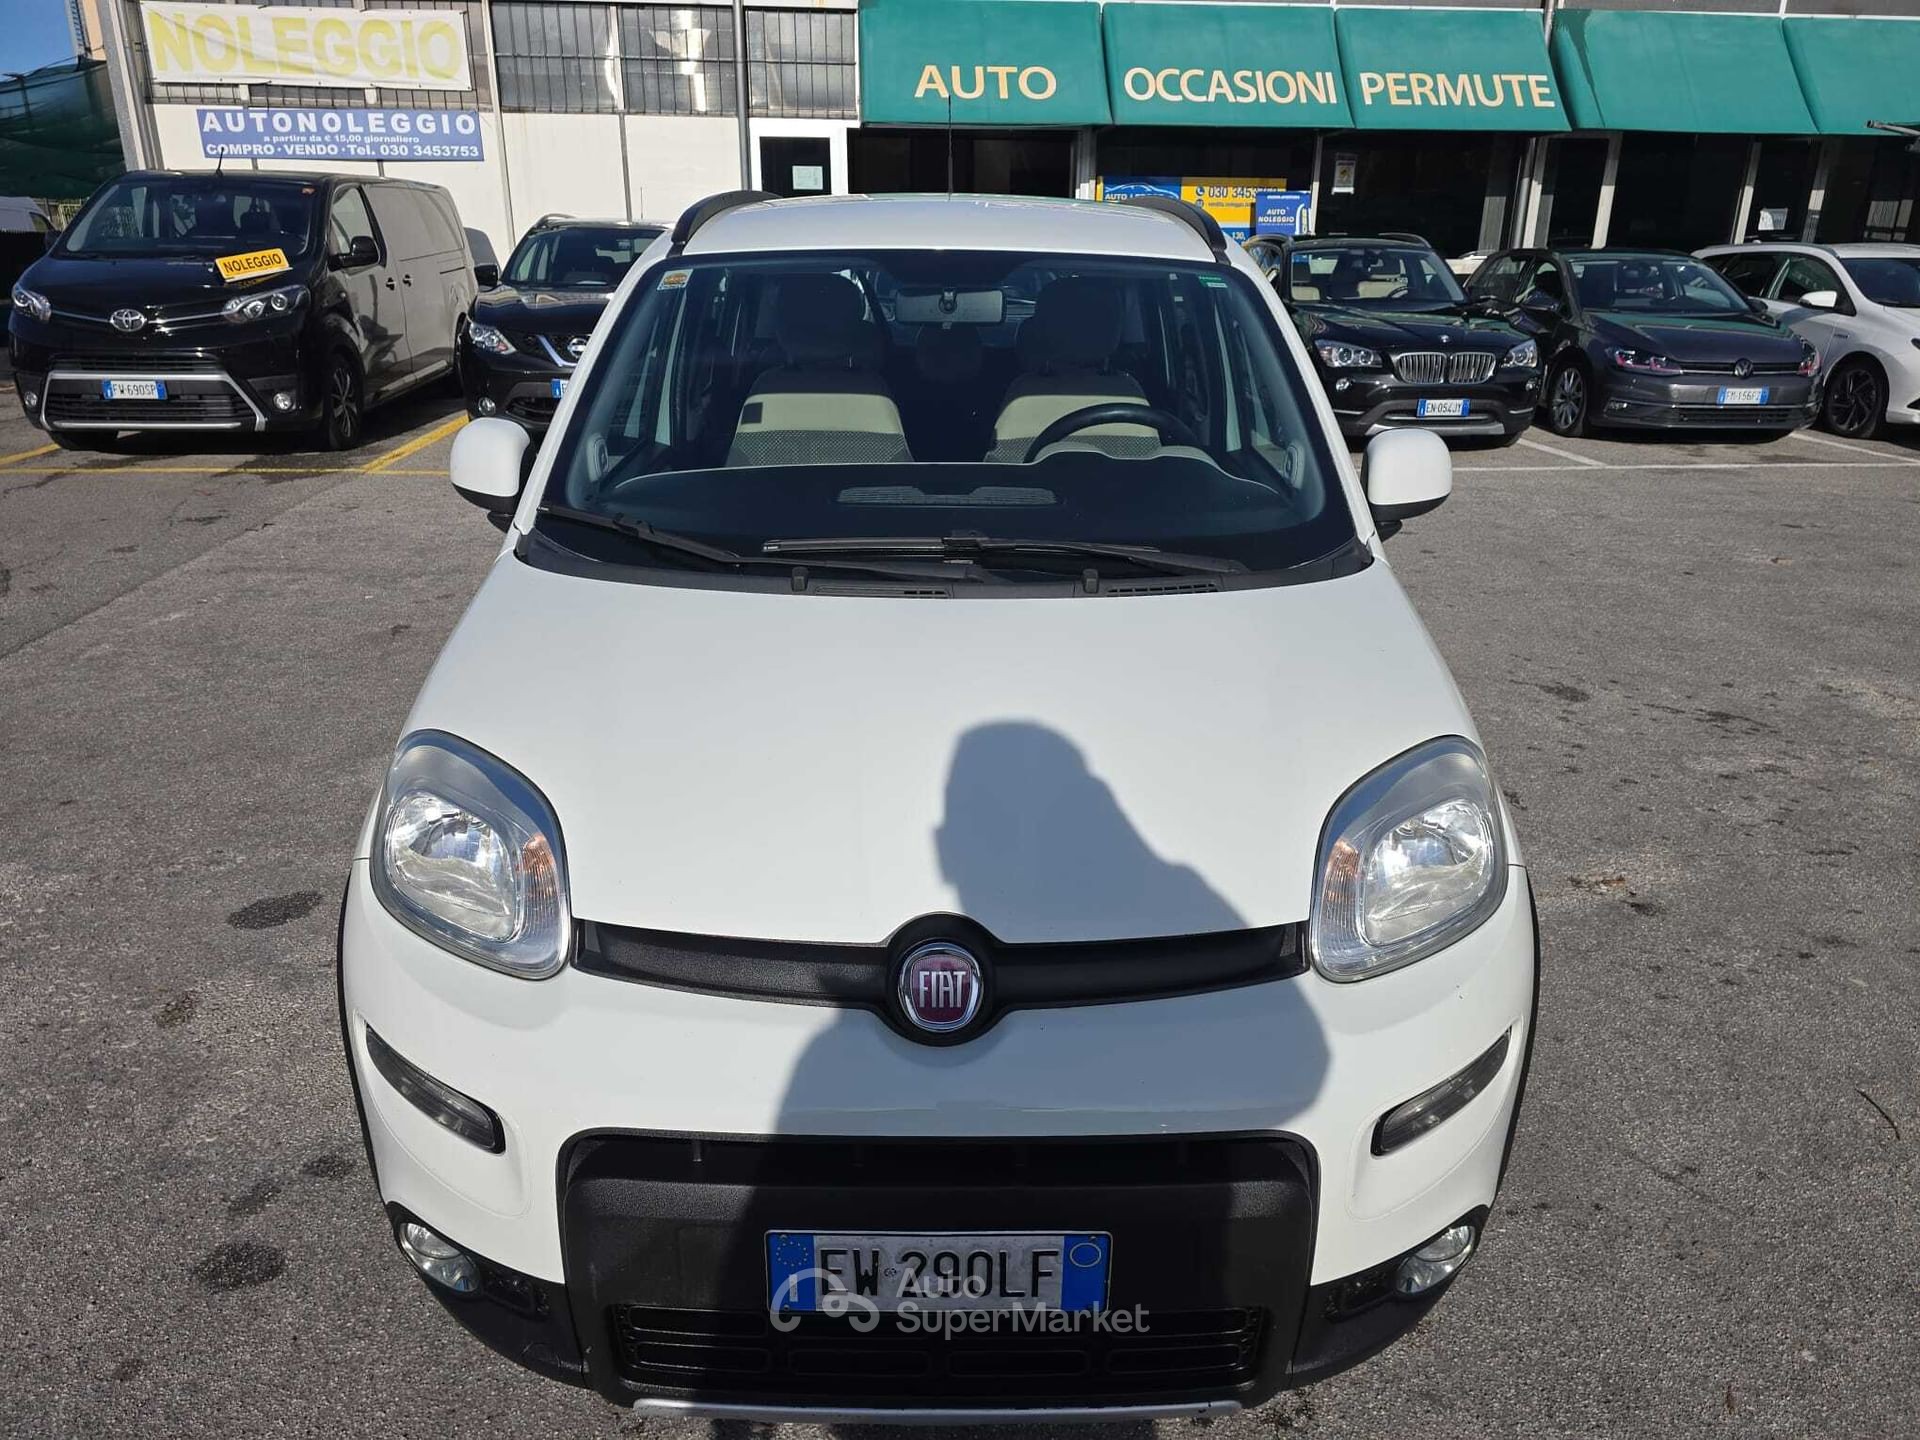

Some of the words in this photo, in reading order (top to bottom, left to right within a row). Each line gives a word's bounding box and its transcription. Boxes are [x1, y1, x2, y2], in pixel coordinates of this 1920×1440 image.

[148, 10, 462, 80] NOLEGGIO
[914, 64, 1057, 101] AUTO
[1124, 66, 1338, 105] OCCASIONI
[1359, 72, 1556, 108] PERMUTE
[203, 111, 476, 135] AUTONOLEGGIO
[206, 143, 275, 155] COMPRO
[283, 144, 339, 155] VENDO
[347, 144, 376, 156] Tel.
[380, 145, 409, 156] 030
[413, 145, 479, 157] 3453753
[273, 134, 307, 144] partire
[309, 134, 322, 142] da
[324, 134, 333, 142] €
[335, 134, 361, 144] 15,00
[363, 134, 420, 144] giornaliero
[1208, 186, 1229, 198] 030
[223, 253, 282, 273] NOLEGGIO
[919, 970, 967, 1009] FIAT
[820, 1248, 881, 1297] EW
[901, 1249, 1060, 1299] 290LF
